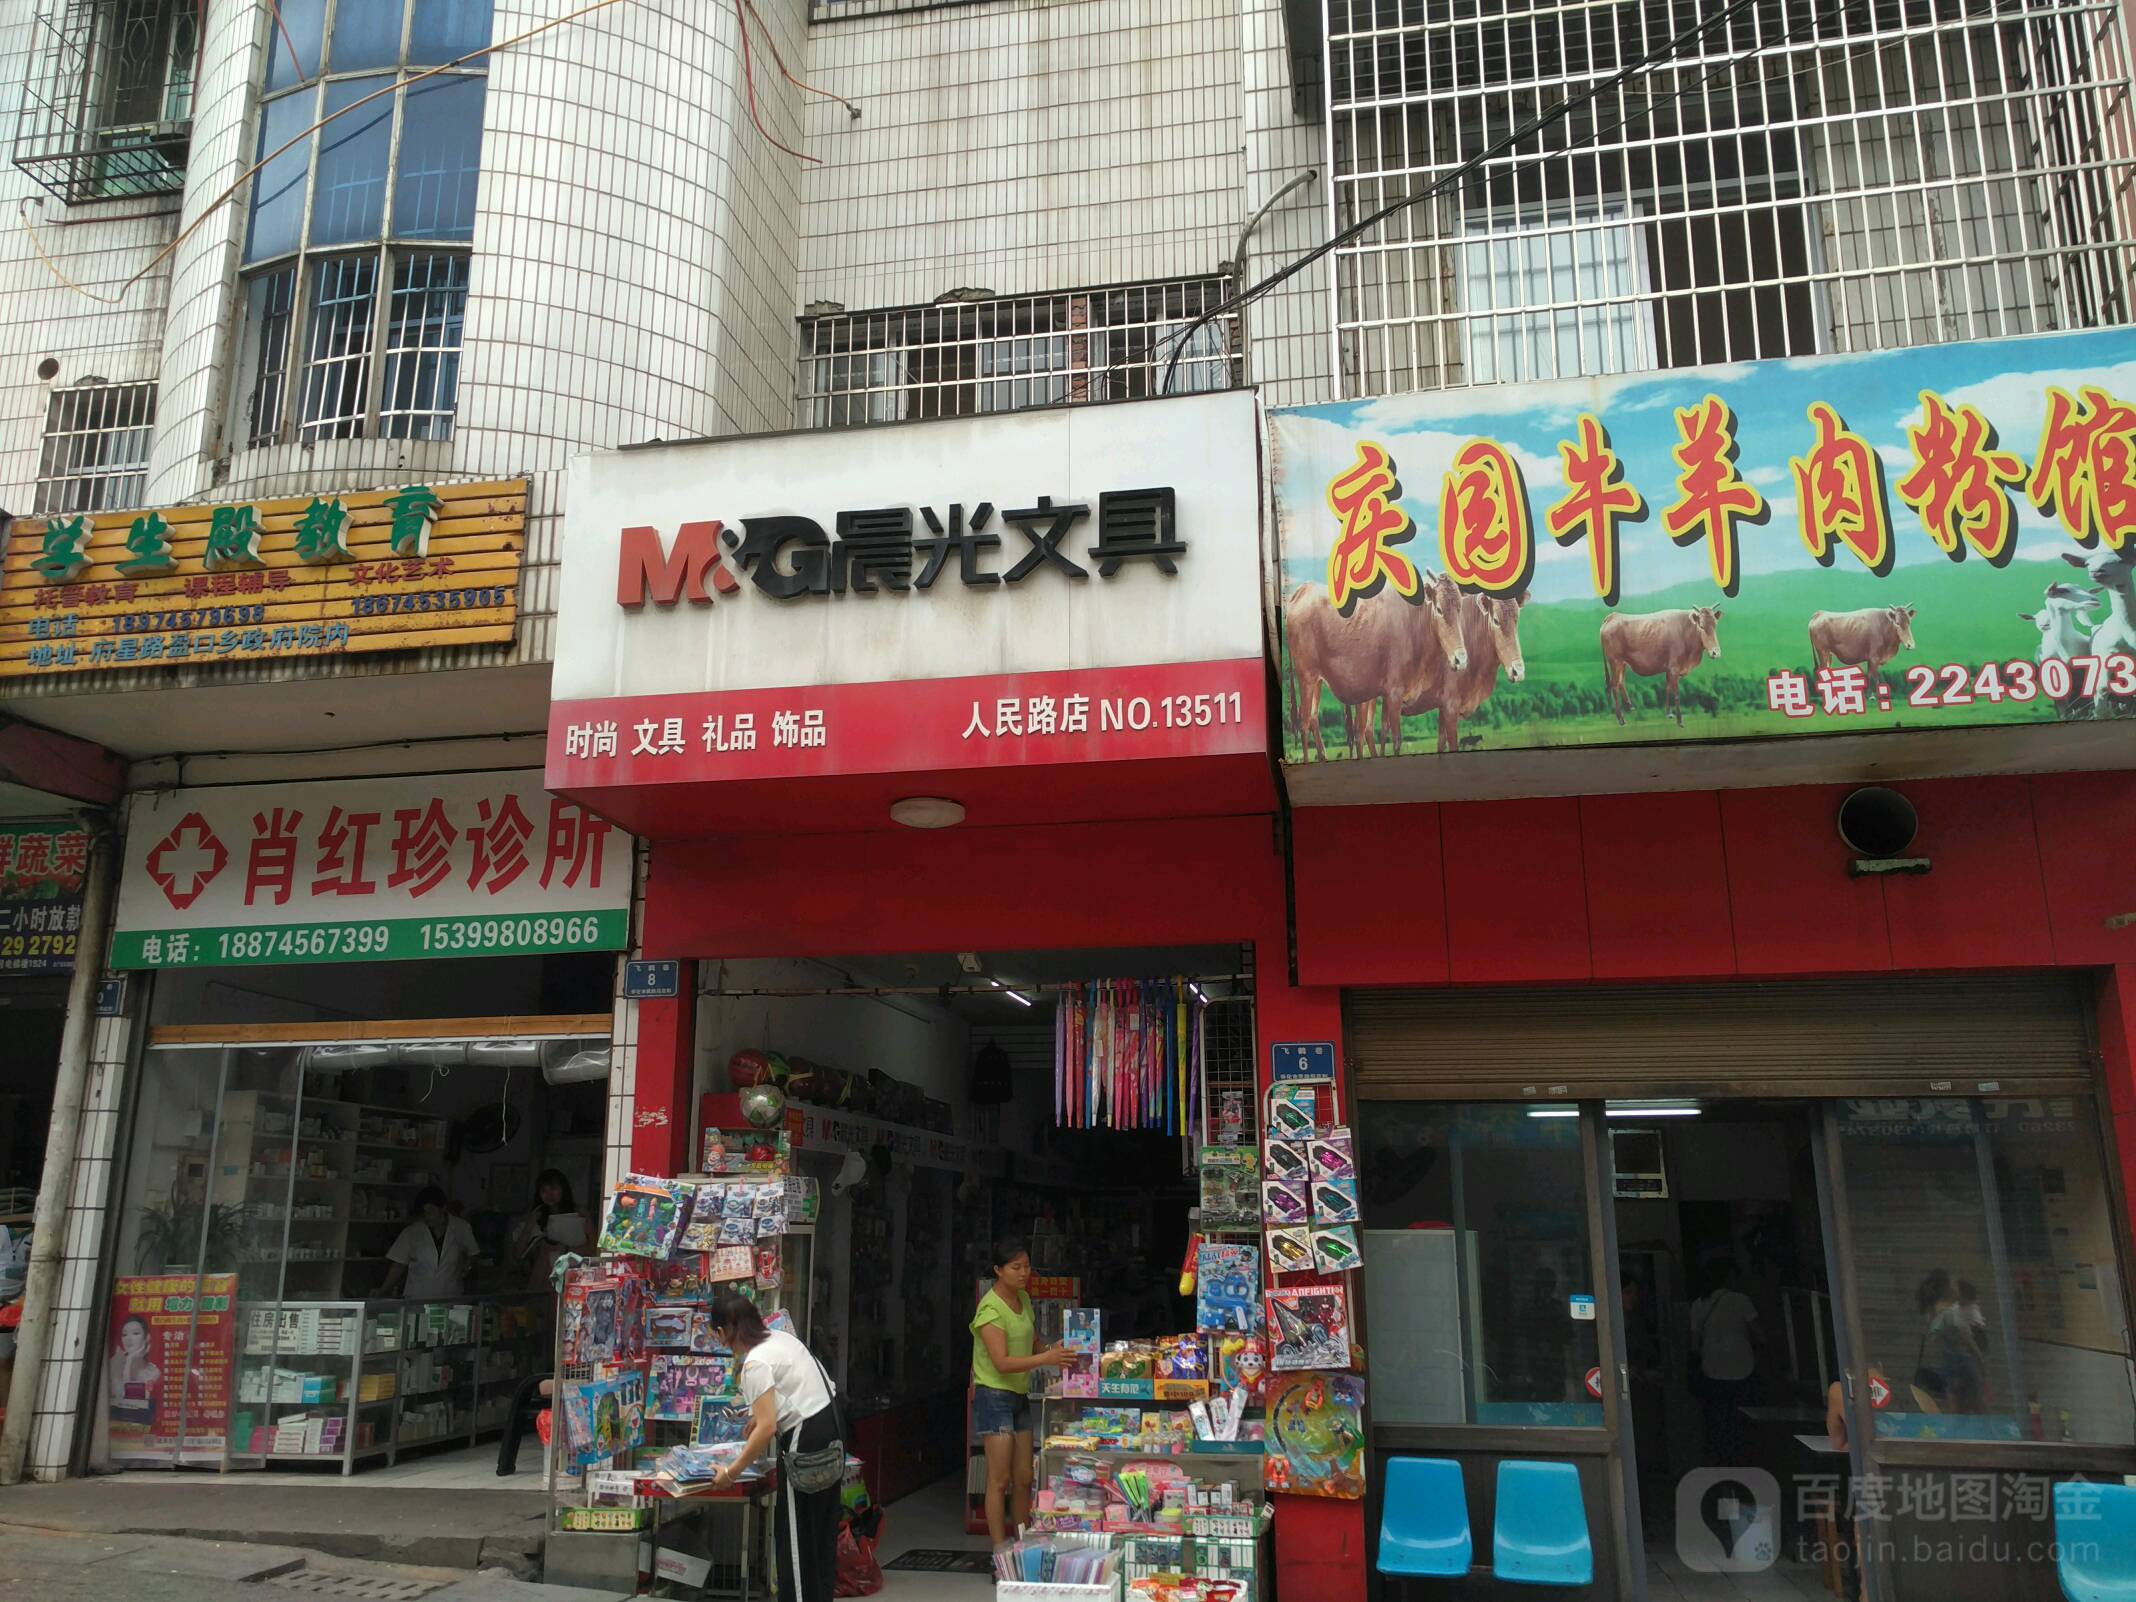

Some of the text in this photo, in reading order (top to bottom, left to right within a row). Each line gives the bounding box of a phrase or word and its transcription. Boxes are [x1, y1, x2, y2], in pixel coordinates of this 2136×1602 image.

[34, 558, 455, 610] 托管教育 课程辅导 文化艺术
[28, 613, 79, 639] 电话
[28, 624, 349, 667] 地址 府星路盈口乡政府院内
[564, 691, 1243, 759] 时尚 文具 礼品 饰品 人民路店 NO.13511
[244, 794, 612, 906] 肖红珍诊所
[217, 926, 390, 959] 18874567399
[420, 916, 600, 951] 15399808966
[647, 973, 656, 986] 8
[1298, 1056, 1308, 1071] 6
